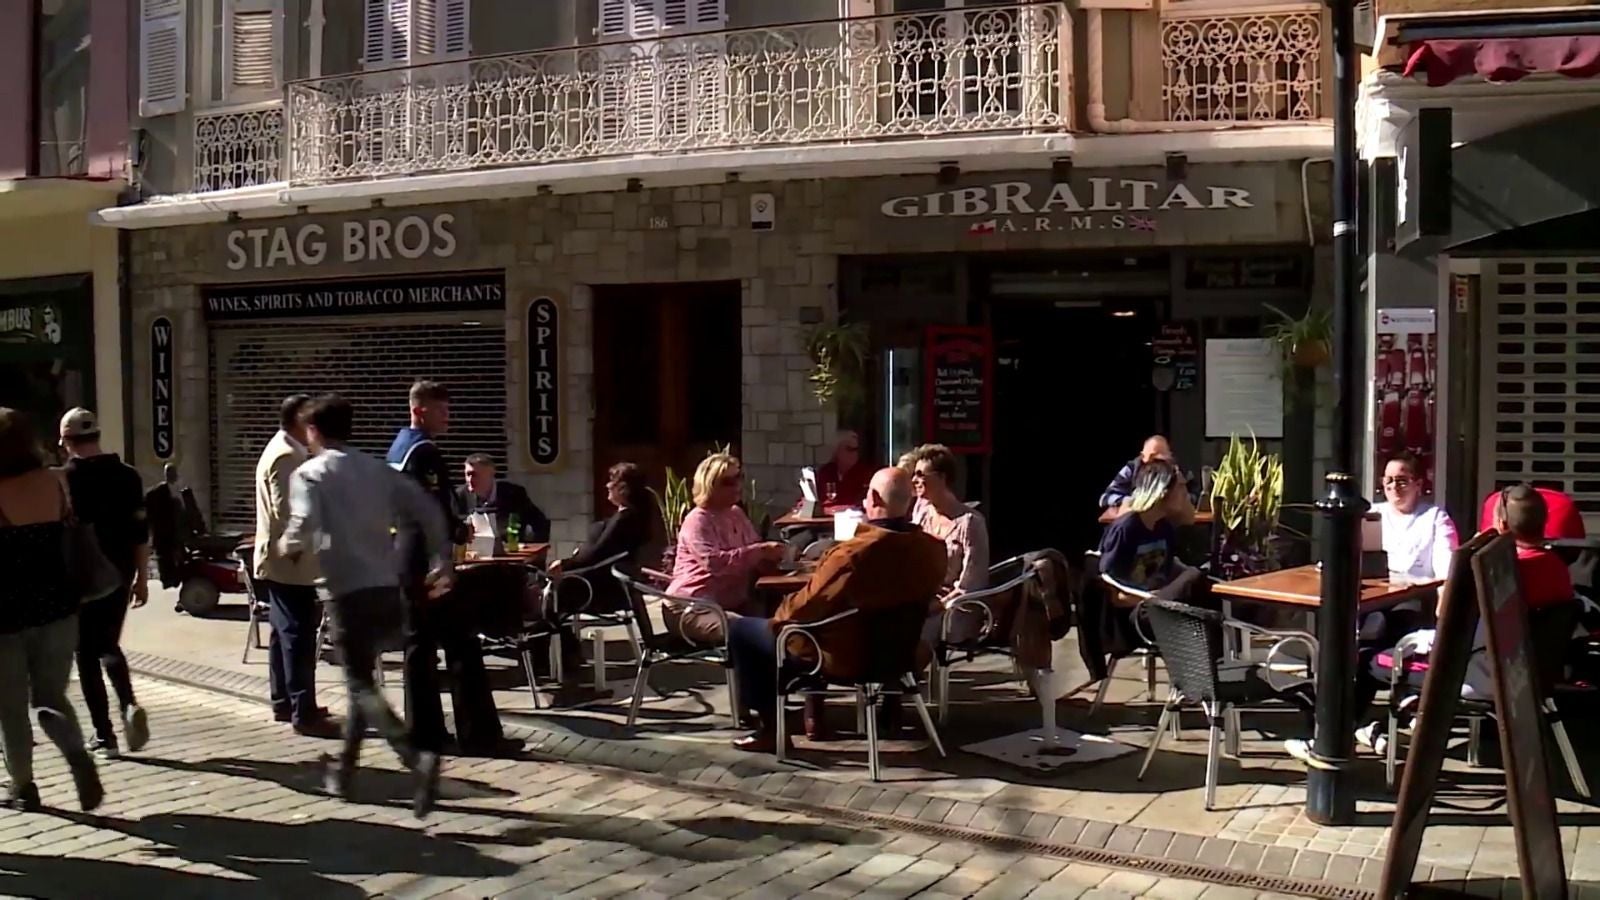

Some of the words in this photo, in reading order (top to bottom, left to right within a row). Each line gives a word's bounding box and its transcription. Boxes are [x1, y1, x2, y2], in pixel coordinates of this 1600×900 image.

[881, 177, 1254, 217] GIBRALTAR
[227, 223, 327, 270] STAG
[343, 213, 456, 262] BROS
[649, 216, 668, 229] 186
[208, 296, 252, 312] WINES,
[254, 292, 302, 310] SPIRITS
[306, 290, 333, 307] AND
[336, 288, 403, 306] TOBACCO
[408, 283, 502, 304] MERCHANTS
[154, 326, 169, 452] WINES
[535, 304, 552, 457] SPIRITS
